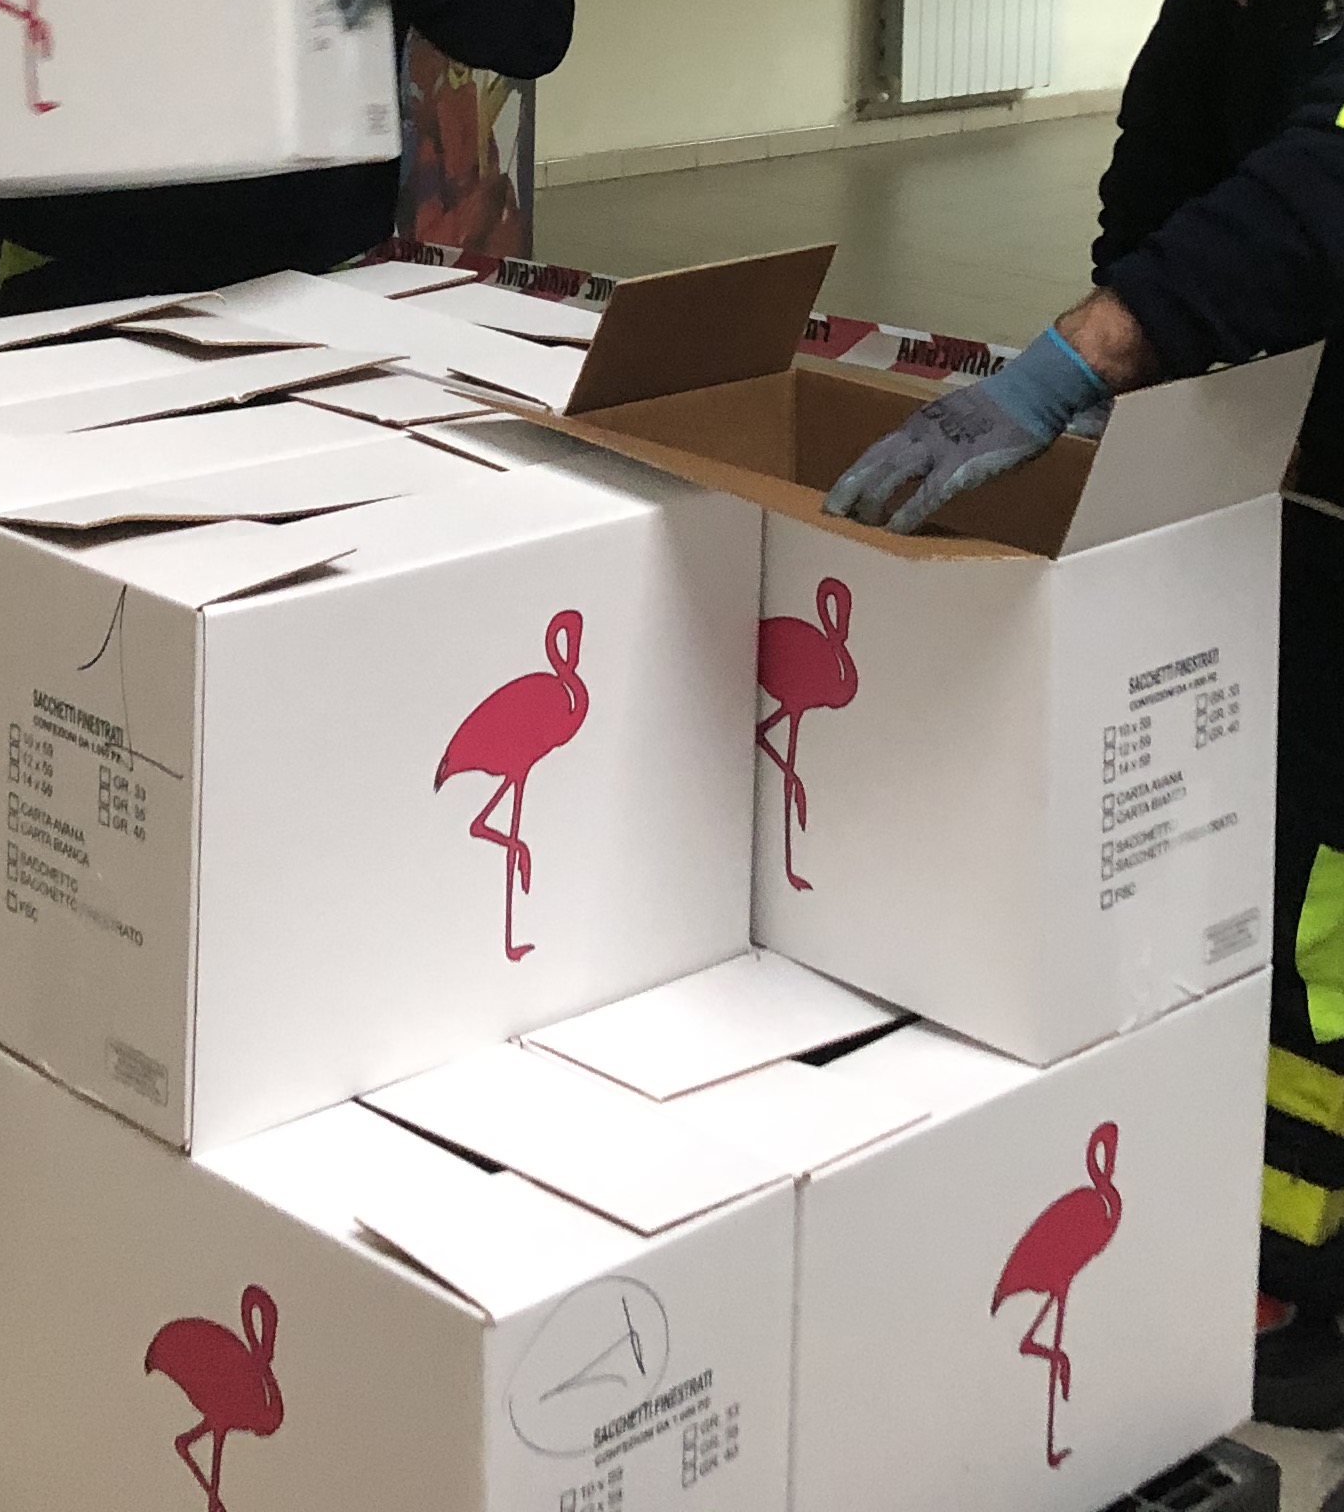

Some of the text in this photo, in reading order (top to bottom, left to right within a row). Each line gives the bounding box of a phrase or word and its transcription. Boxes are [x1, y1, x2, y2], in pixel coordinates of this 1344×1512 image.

[32, 688, 124, 749] SACCHETTI FINESTRATI
[593, 1367, 714, 1450] SACCHETTI FINESTRATI
